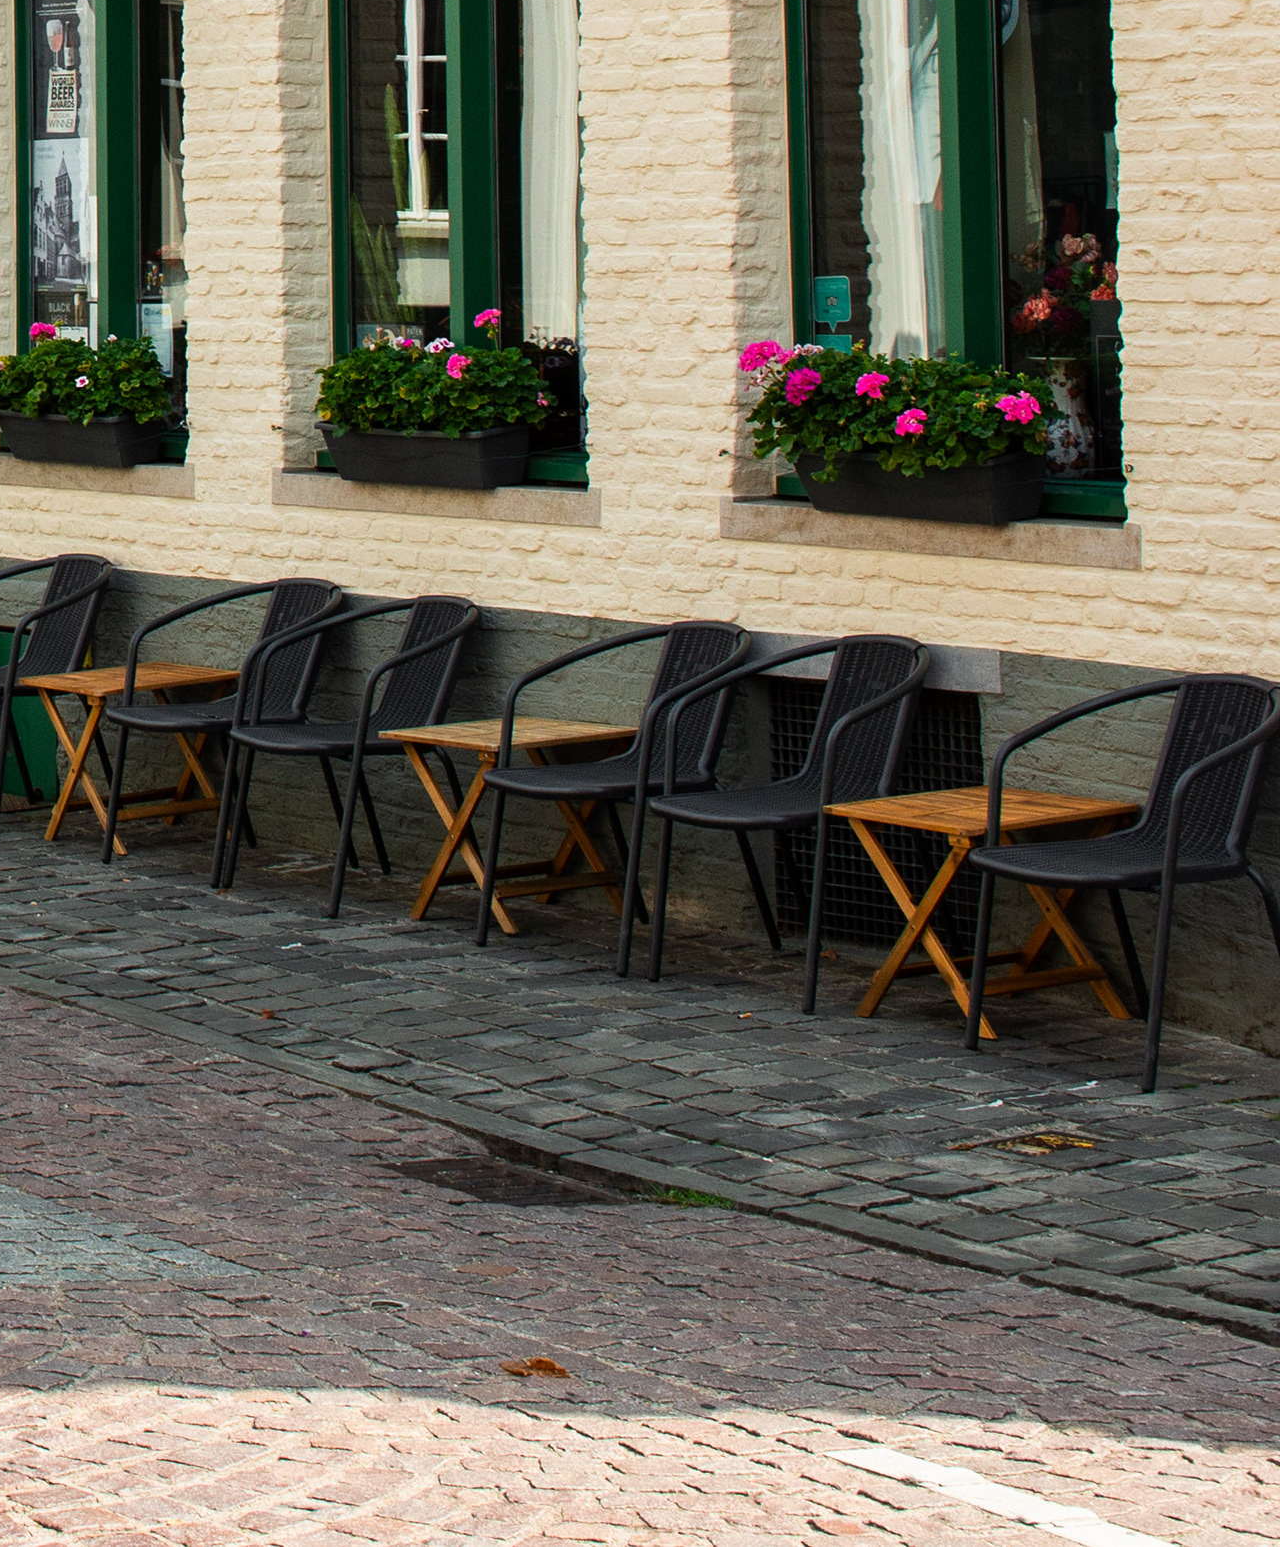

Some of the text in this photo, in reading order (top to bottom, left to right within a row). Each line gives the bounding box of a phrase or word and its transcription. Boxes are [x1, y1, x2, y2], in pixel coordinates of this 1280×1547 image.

[51, 77, 74, 86] WORLD
[51, 87, 74, 100] BEER
[49, 100, 74, 108] AWARDS
[48, 302, 71, 313] BLACK
